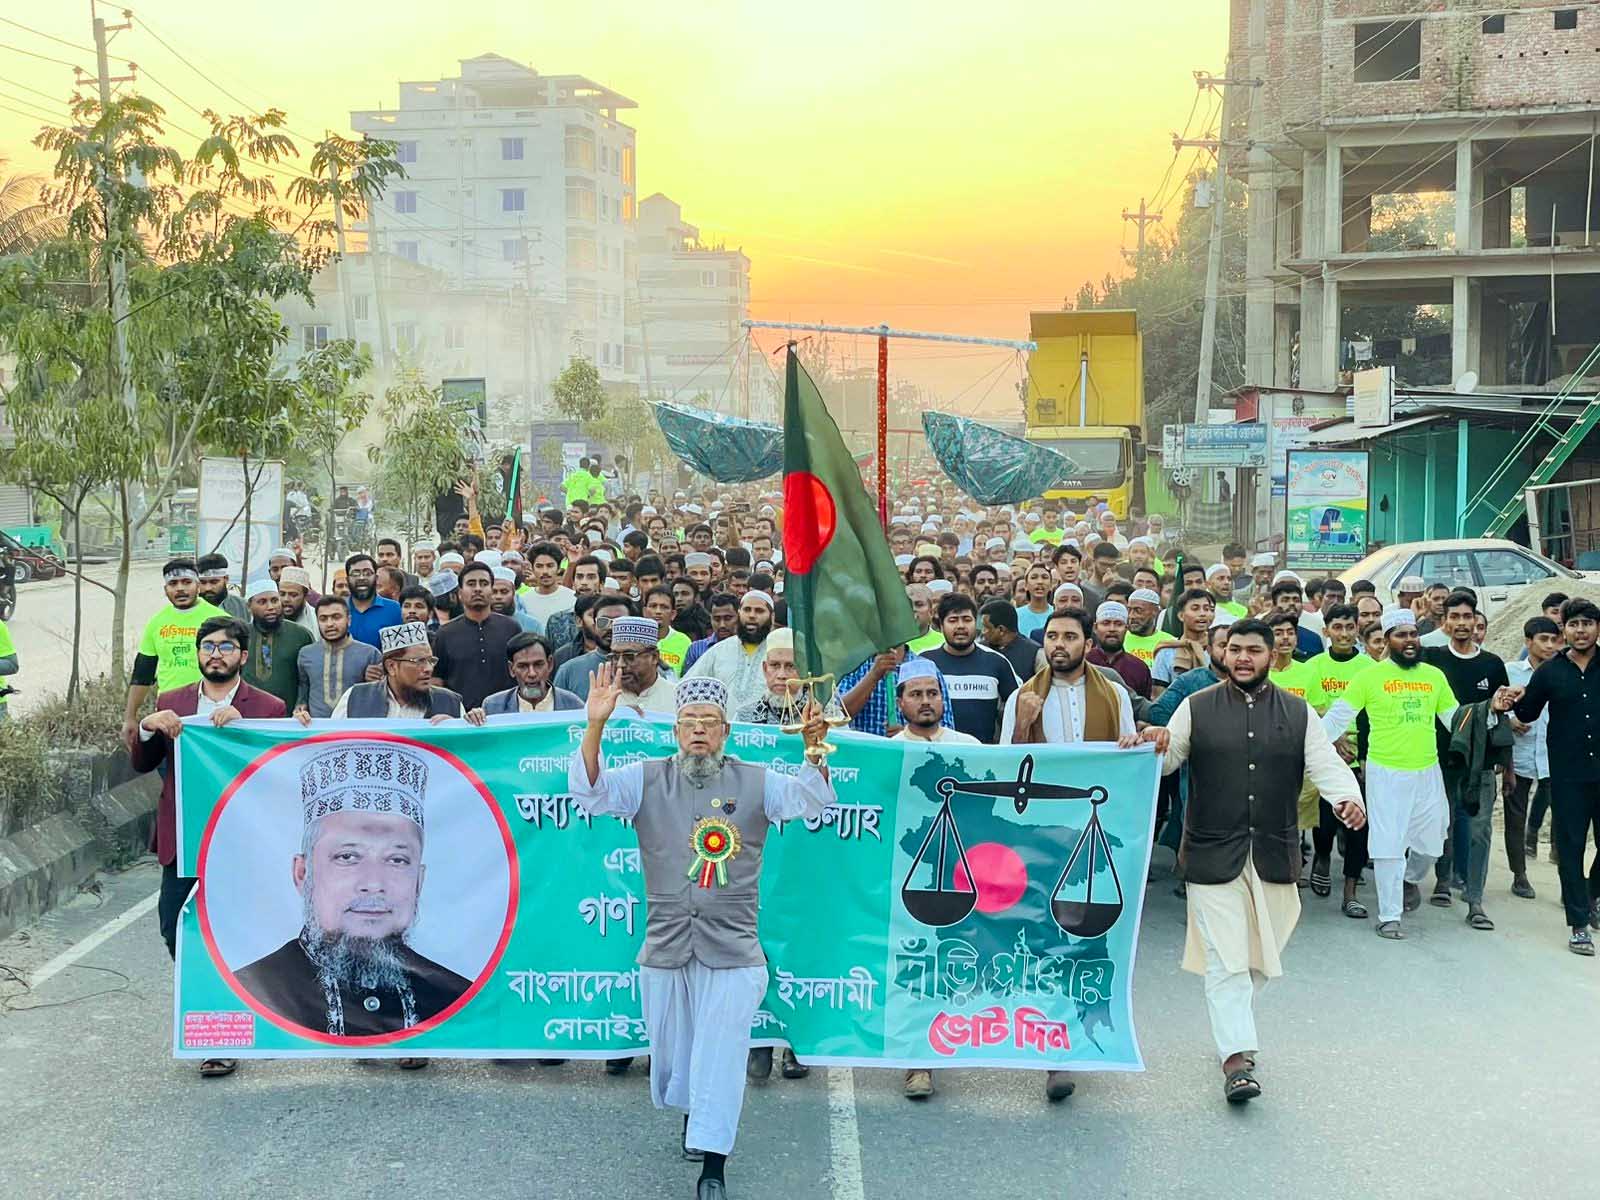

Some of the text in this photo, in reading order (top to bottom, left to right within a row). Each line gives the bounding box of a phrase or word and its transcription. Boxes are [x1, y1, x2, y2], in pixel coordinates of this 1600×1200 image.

[831, 766, 861, 783] সনে
[603, 847, 641, 874] এর
[578, 891, 641, 937] গণ
[505, 965, 880, 1010] বাংলাদেশ ইসলামী
[543, 1011, 650, 1041] সোনাইমু
[928, 1006, 1071, 1056] ভোট দিন
